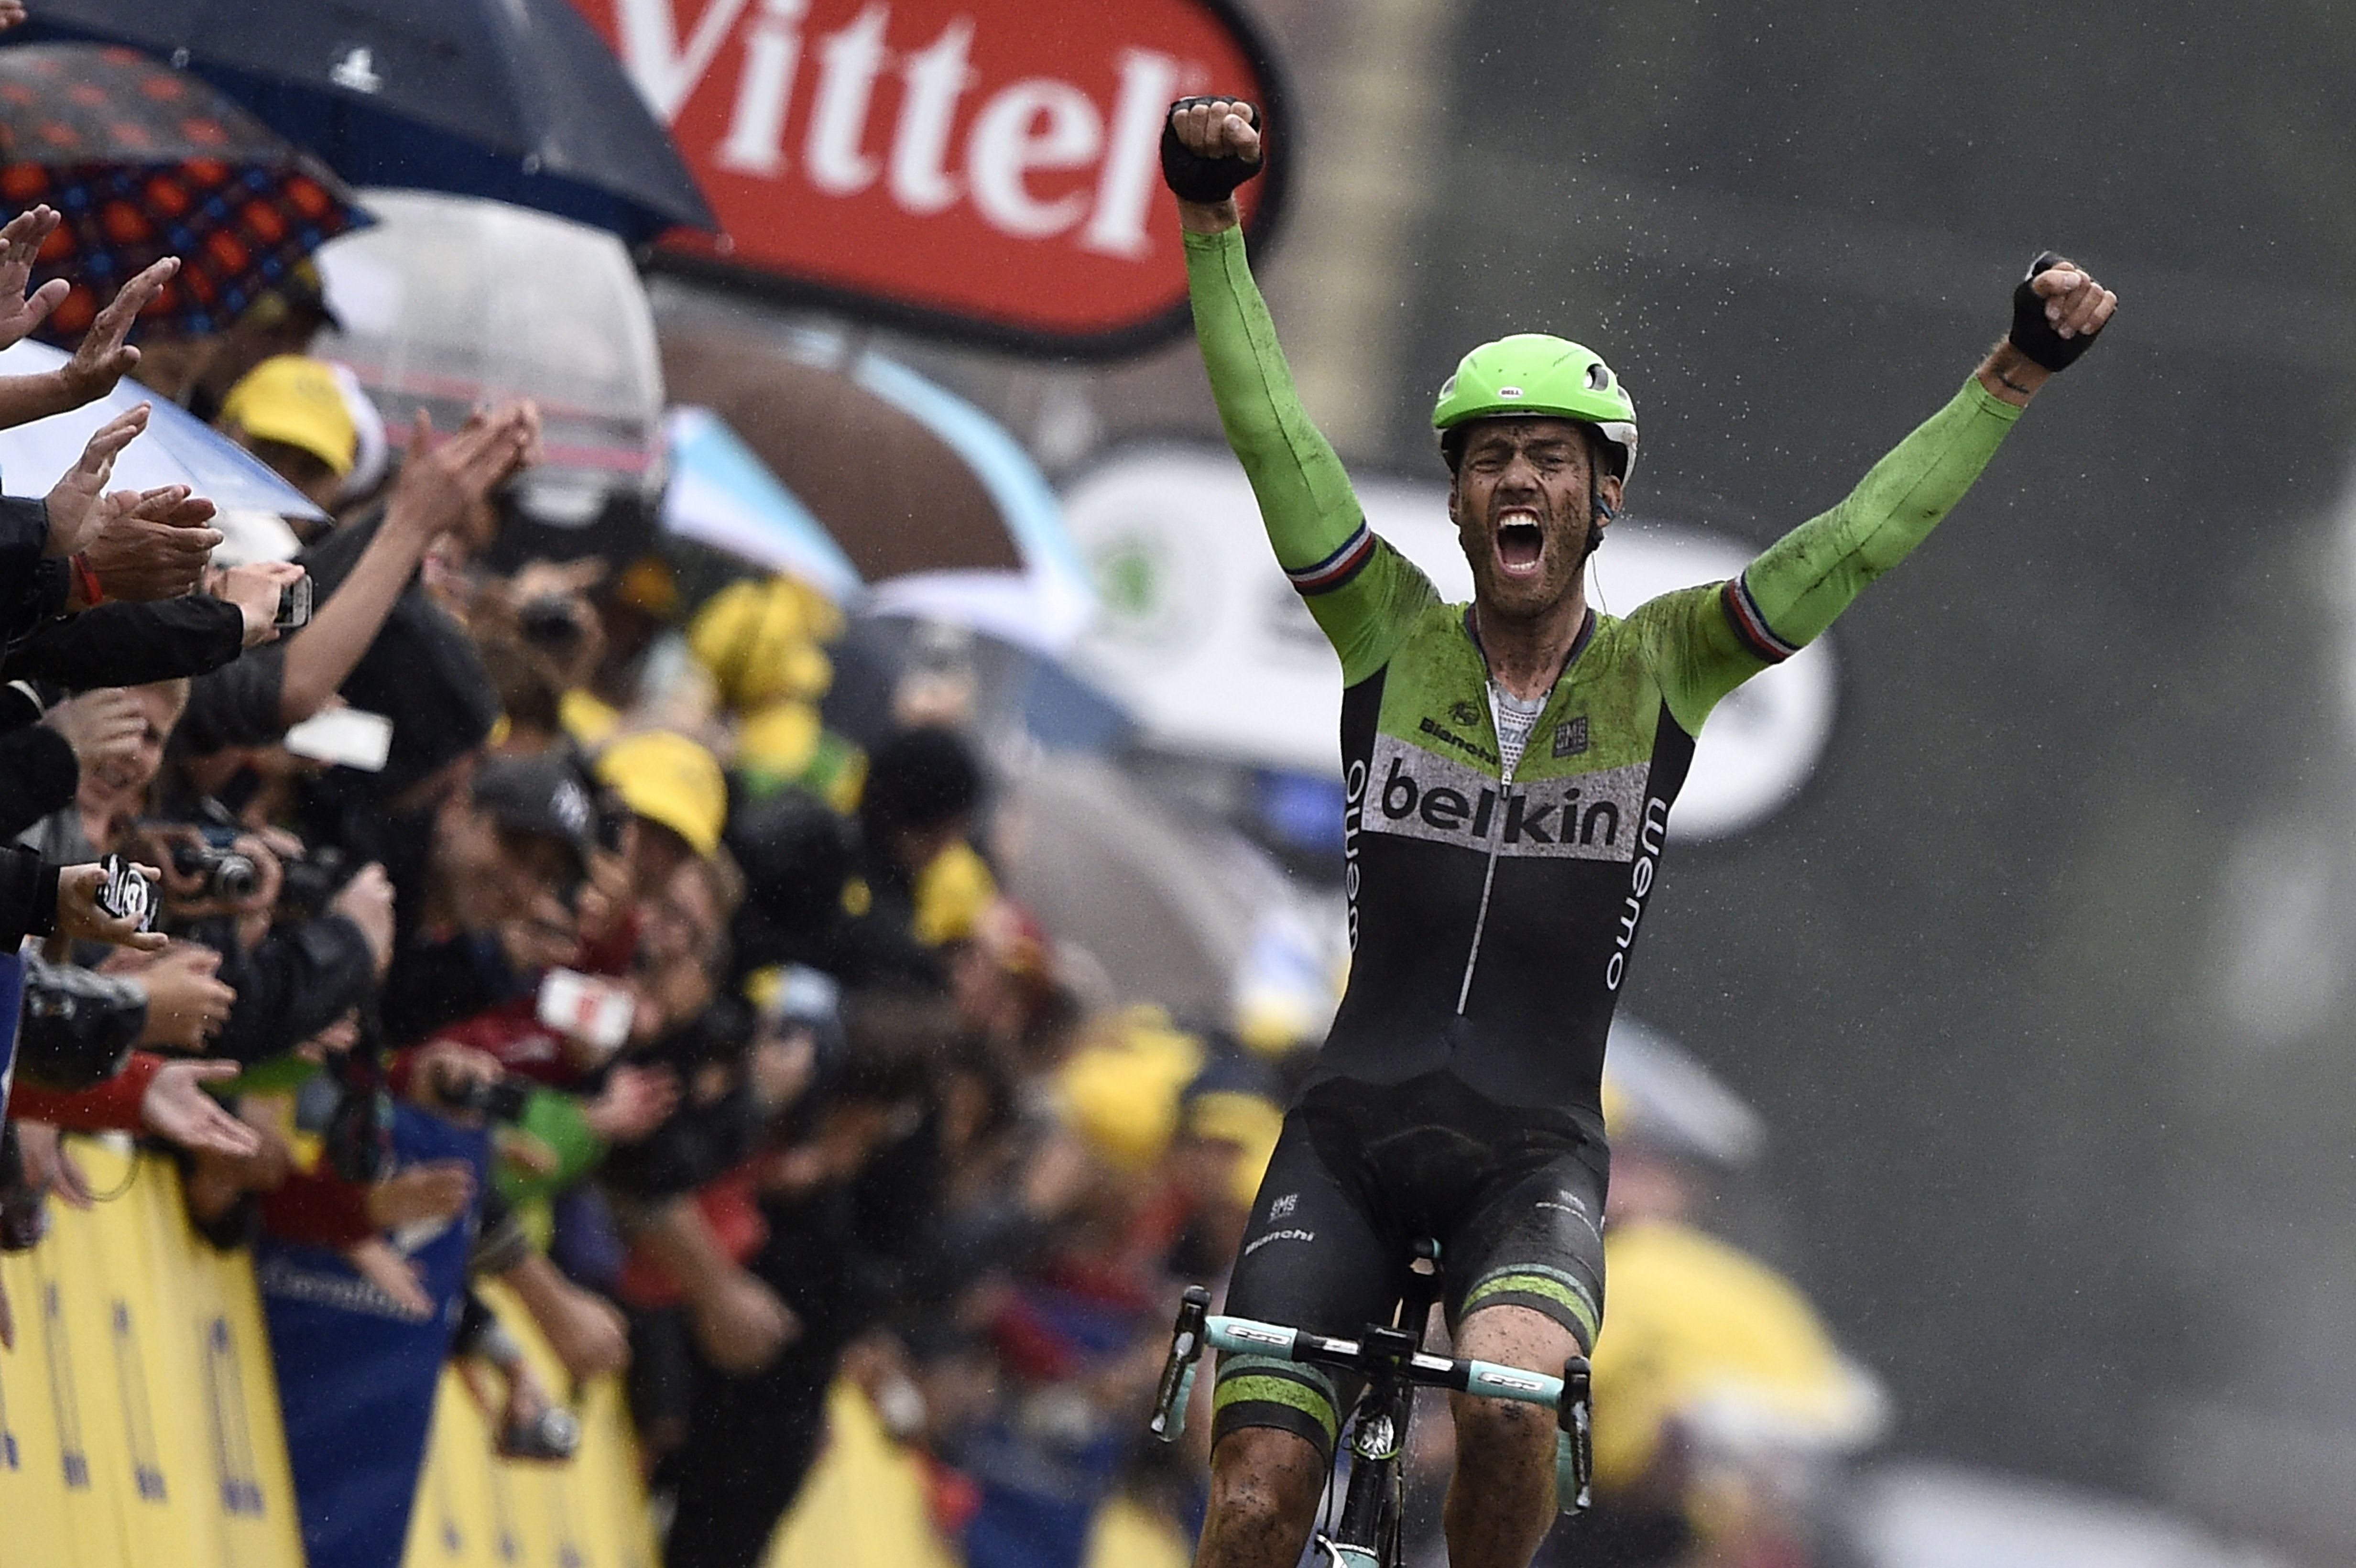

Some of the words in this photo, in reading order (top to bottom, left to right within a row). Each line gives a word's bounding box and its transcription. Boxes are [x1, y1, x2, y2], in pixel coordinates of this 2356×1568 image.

[613, 0, 1179, 261] Vittel
[1382, 757, 1619, 845] belkin
[1419, 717, 1497, 765] Bianchi
[1606, 797, 1666, 990] wemo
